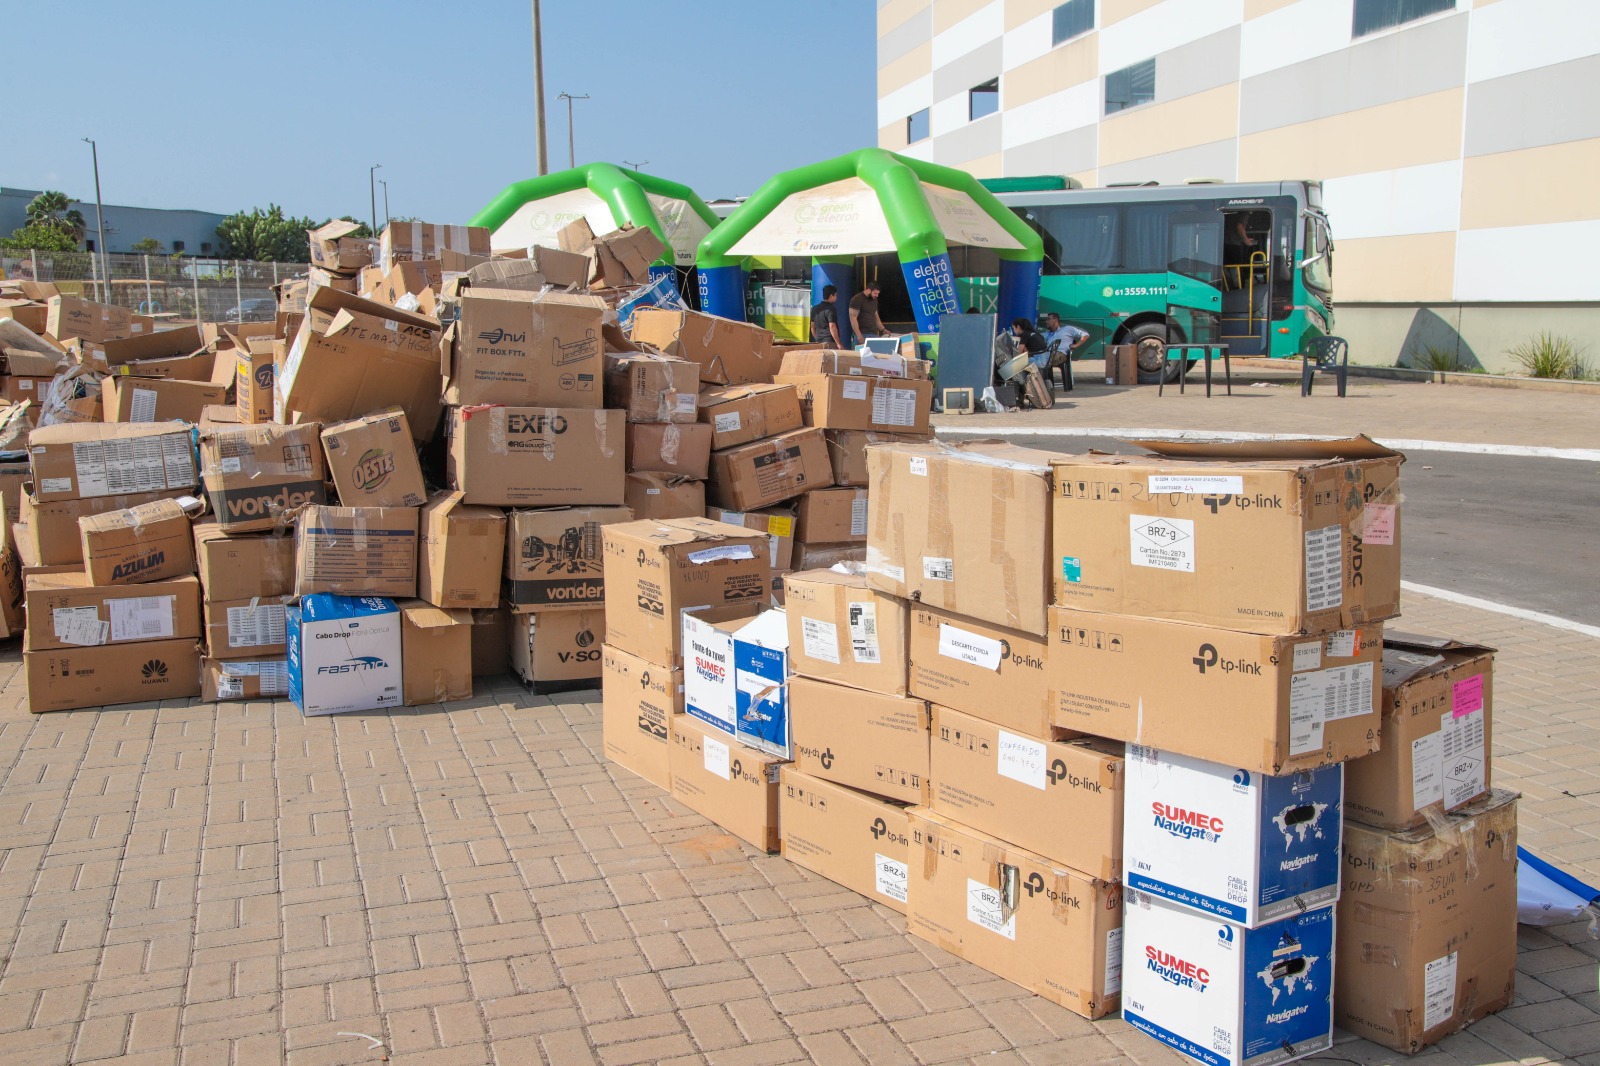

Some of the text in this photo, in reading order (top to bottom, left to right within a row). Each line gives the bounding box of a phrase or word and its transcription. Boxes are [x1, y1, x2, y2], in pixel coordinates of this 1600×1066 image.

[820, 202, 854, 214] green
[817, 211, 859, 224] eletron
[809, 239, 839, 251] futuro
[913, 259, 949, 279] eletrô
[919, 284, 954, 303] não é
[970, 286, 998, 312] lix
[1115, 287, 1168, 297] 61 3559.1111
[477, 347, 488, 355] FIT
[490, 348, 507, 357] BOX
[388, 420, 400, 429] 06
[327, 436, 339, 445] 06
[352, 452, 395, 489] OESTE
[227, 487, 316, 518] vonder
[1235, 493, 1282, 511] tp-link
[1148, 526, 1176, 541] BRZ-g
[1139, 546, 1159, 556] Carton
[112, 551, 166, 580] AZULIM
[645, 557, 661, 569] tp-link
[547, 585, 604, 601] vonder
[1238, 607, 1256, 616] MADE
[1263, 610, 1284, 619] CHINA
[316, 632, 333, 640] Cabo
[334, 631, 351, 639] Drop
[951, 638, 973, 652] DESCARTE
[695, 656, 726, 677] SUMEC
[1012, 651, 1043, 671] tp-link
[1220, 657, 1262, 676] tp-link
[141, 677, 169, 685] HUAWEI
[696, 665, 725, 685] Navigator
[651, 680, 666, 693] tp-link
[800, 746, 820, 759] tp-link
[742, 769, 760, 787] tp-link
[1454, 763, 1473, 776] BRZ-v
[1069, 775, 1102, 794] tp-link
[1152, 801, 1224, 834] SUMEC
[1366, 806, 1384, 817] CHINA
[887, 828, 908, 848] tp-lin
[1153, 815, 1221, 844] Navigator
[1280, 853, 1319, 872] Navigator
[1228, 875, 1248, 887] CABLE
[1228, 882, 1248, 893] FIBRA
[1046, 886, 1080, 909] tp-link
[1138, 880, 1166, 894] especialista
[1168, 889, 1176, 898] em
[1177, 891, 1190, 902] cabo
[1191, 896, 1199, 906] de
[1201, 897, 1215, 910] fibra
[1228, 893, 1248, 904] DROP
[1145, 945, 1210, 984] SUMEC
[1147, 958, 1207, 994] Navigator
[1045, 978, 1059, 990] MADE
[1064, 986, 1080, 999] CHINA
[1266, 1005, 1309, 1025] Navigator
[1213, 1026, 1232, 1038] CABLE
[1346, 1012, 1365, 1025] MADE
[1373, 1021, 1396, 1036] CHINA
[1132, 1018, 1157, 1036] especialista
[1158, 1032, 1167, 1040] em
[1167, 1035, 1180, 1047] cabo
[1180, 1042, 1188, 1050] de
[1189, 1044, 1202, 1059] fibra
[1213, 1032, 1232, 1045] FIBRA
[1213, 1043, 1232, 1056] DROP
